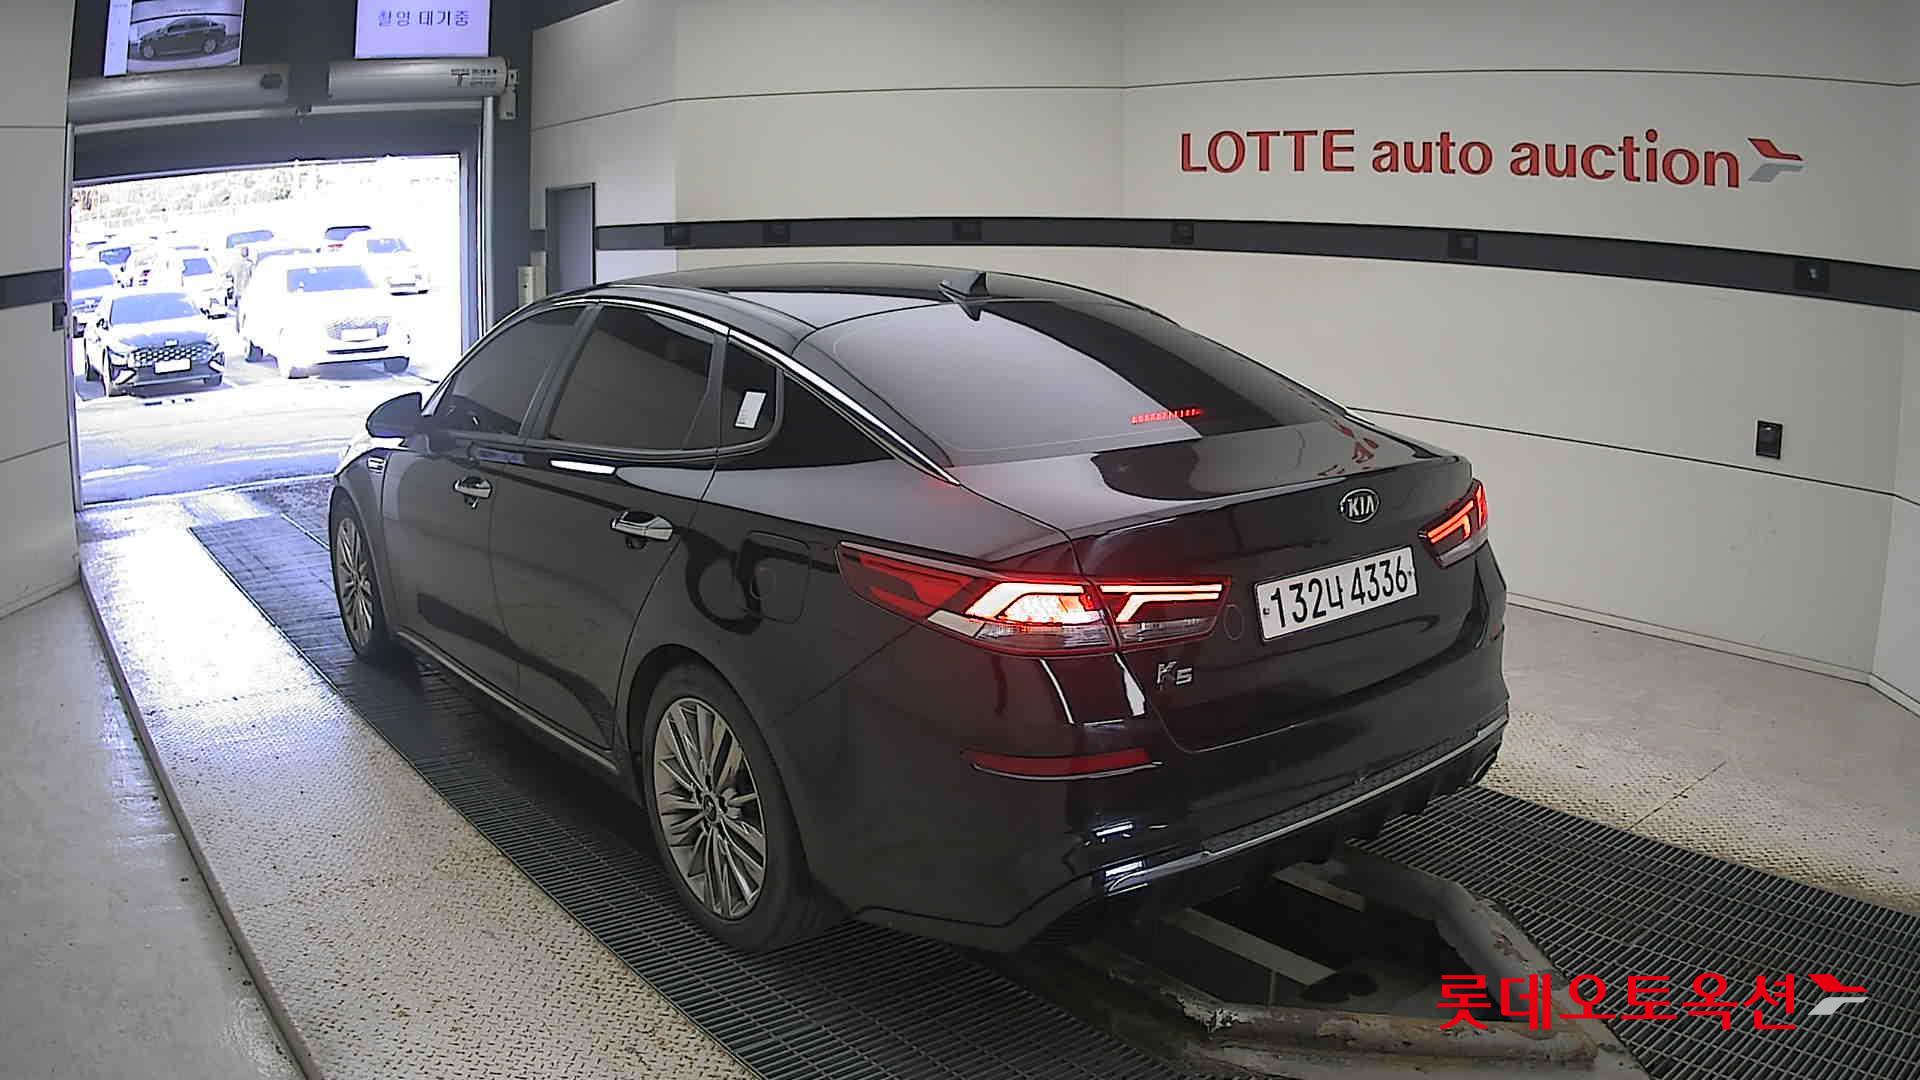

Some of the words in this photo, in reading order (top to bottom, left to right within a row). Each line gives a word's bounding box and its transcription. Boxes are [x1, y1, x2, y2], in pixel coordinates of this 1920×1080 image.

[418, 10, 470, 27] 대기중
[1180, 129, 1356, 174] LOTTE
[1371, 131, 1493, 177] auto
[1509, 129, 1741, 189] auction
[1347, 494, 1375, 518] KIA
[1350, 555, 1408, 606] 4336
[1156, 660, 1193, 685] K5
